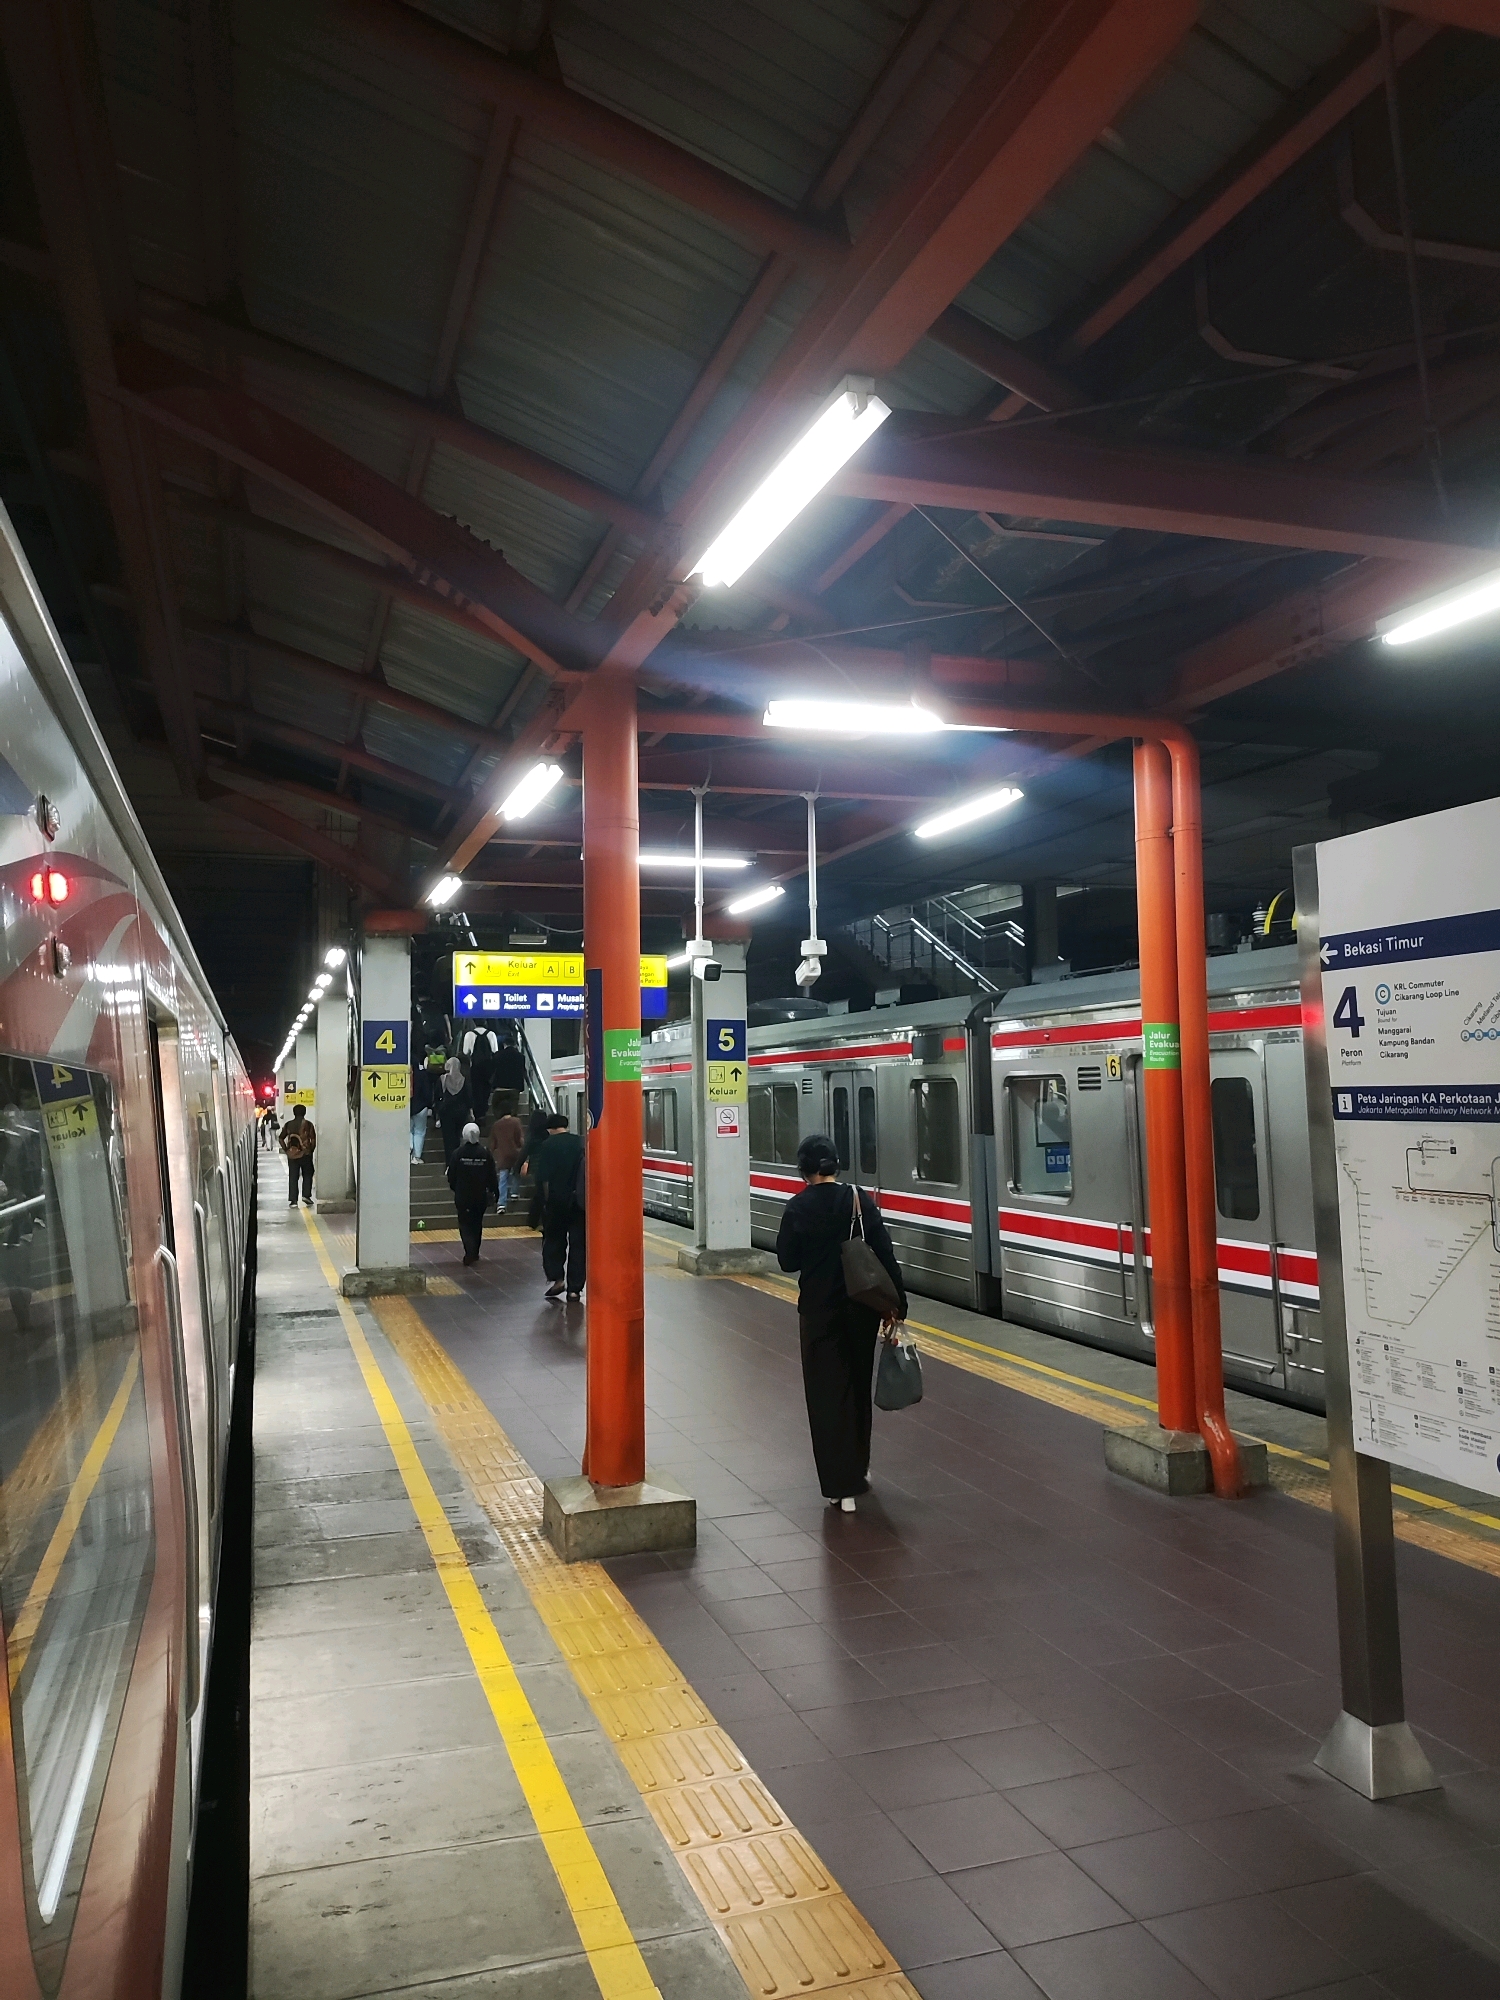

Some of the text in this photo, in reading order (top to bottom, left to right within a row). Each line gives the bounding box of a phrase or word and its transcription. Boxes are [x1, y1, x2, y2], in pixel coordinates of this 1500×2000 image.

[1343, 935, 1424, 957] Bekasi Timur
[507, 960, 575, 974] Keluar A B
[1393, 980, 1445, 991] KRL Commuter
[503, 993, 528, 1002] Toilet
[1394, 989, 1460, 1001] Cikarang Loop Line
[503, 1002, 531, 1010] Restroom
[1333, 985, 1366, 1039] 4
[1376, 1008, 1397, 1017] Tujuan
[1463, 1001, 1483, 1026] Cikarang
[1149, 1031, 1171, 1039] Jalur
[1378, 1026, 1412, 1035] Manggarai
[375, 1029, 397, 1054] 4
[717, 1027, 736, 1052] 5
[1379, 1037, 1435, 1047] Kampung Bandan
[1340, 1048, 1363, 1057] Peron
[1379, 1051, 1409, 1059] Cikarang
[1110, 1058, 1117, 1077] 6
[287, 1083, 294, 1091] 4
[709, 1087, 738, 1095] Keluar
[373, 1093, 407, 1102] Keluar
[1357, 1093, 1376, 1104] Peta
[1379, 1092, 1420, 1106] Jaringan
[1421, 1092, 1437, 1104] KA
[1439, 1092, 1492, 1104] Perkotaan
[1357, 1105, 1383, 1114] Jakarta
[1384, 1105, 1428, 1116] Metropolitan
[1429, 1105, 1458, 1116] Railway
[1459, 1105, 1492, 1115] Network
